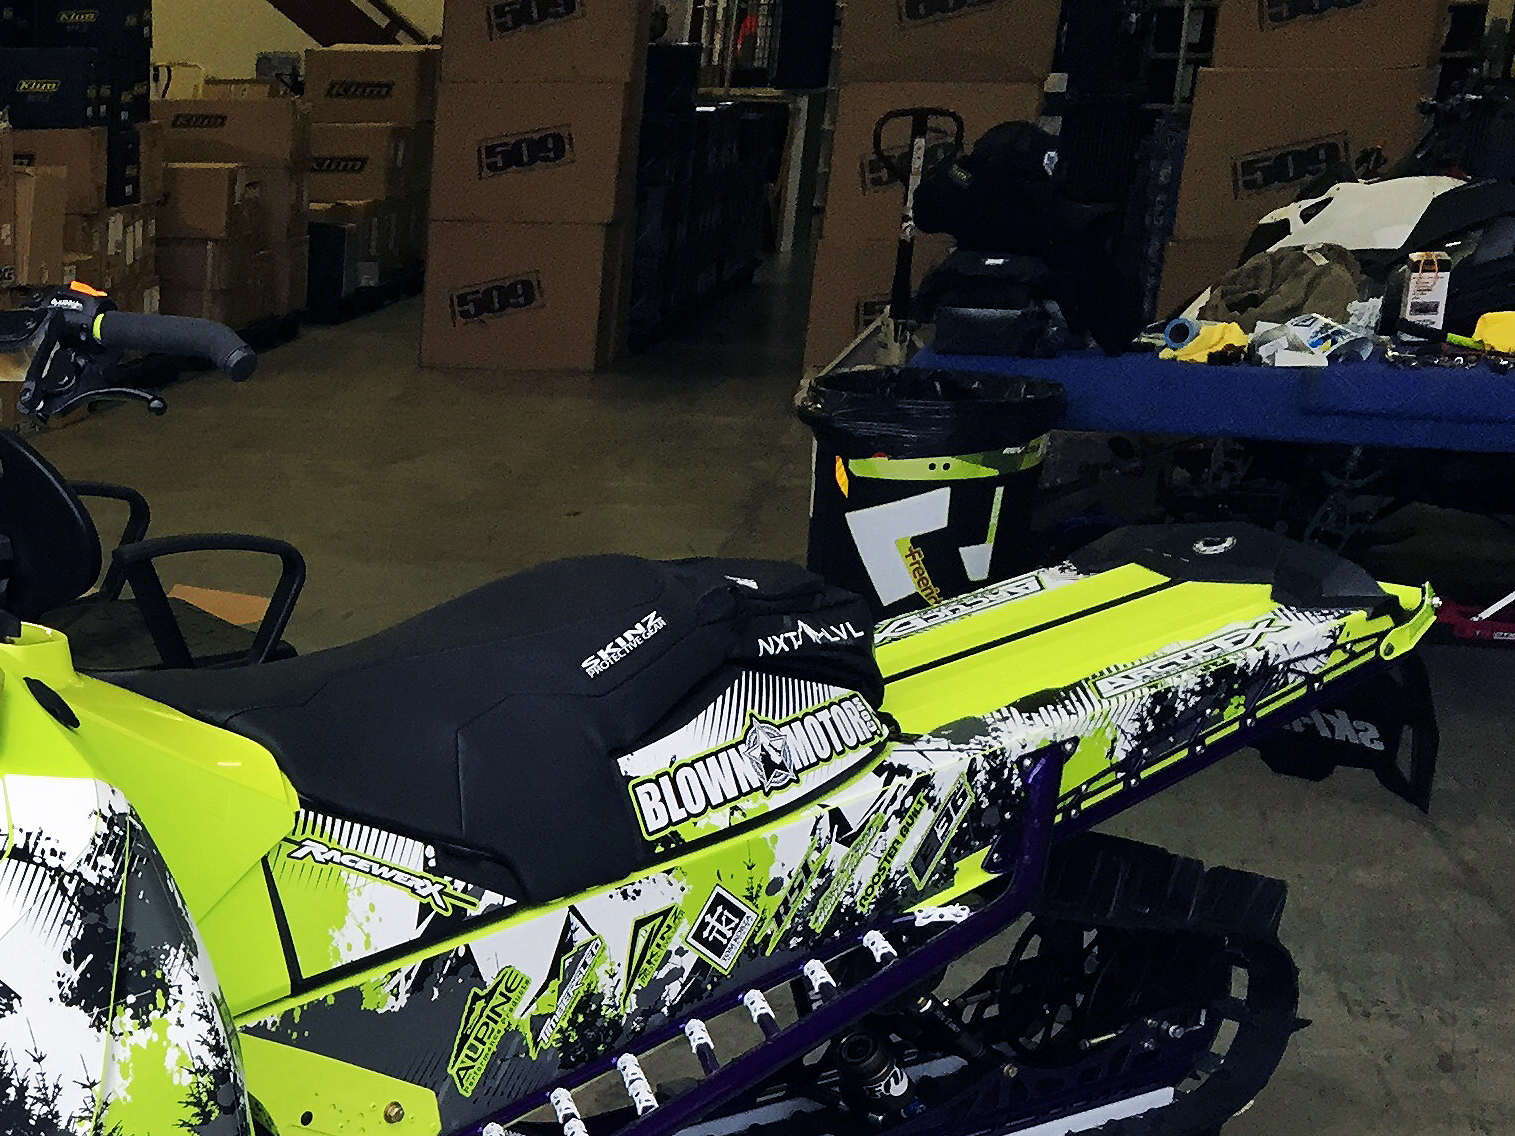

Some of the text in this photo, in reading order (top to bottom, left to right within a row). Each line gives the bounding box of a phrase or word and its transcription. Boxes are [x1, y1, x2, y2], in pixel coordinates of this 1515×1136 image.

[19, 80, 58, 91] Klim
[484, 132, 566, 172] 509
[456, 279, 535, 320] 509
[580, 610, 663, 672] SKINZ
[640, 747, 762, 833] BLOWN
[784, 705, 862, 770] MOTOR
[290, 840, 448, 913] RACEWERX
[456, 970, 524, 1085] ALPINE
